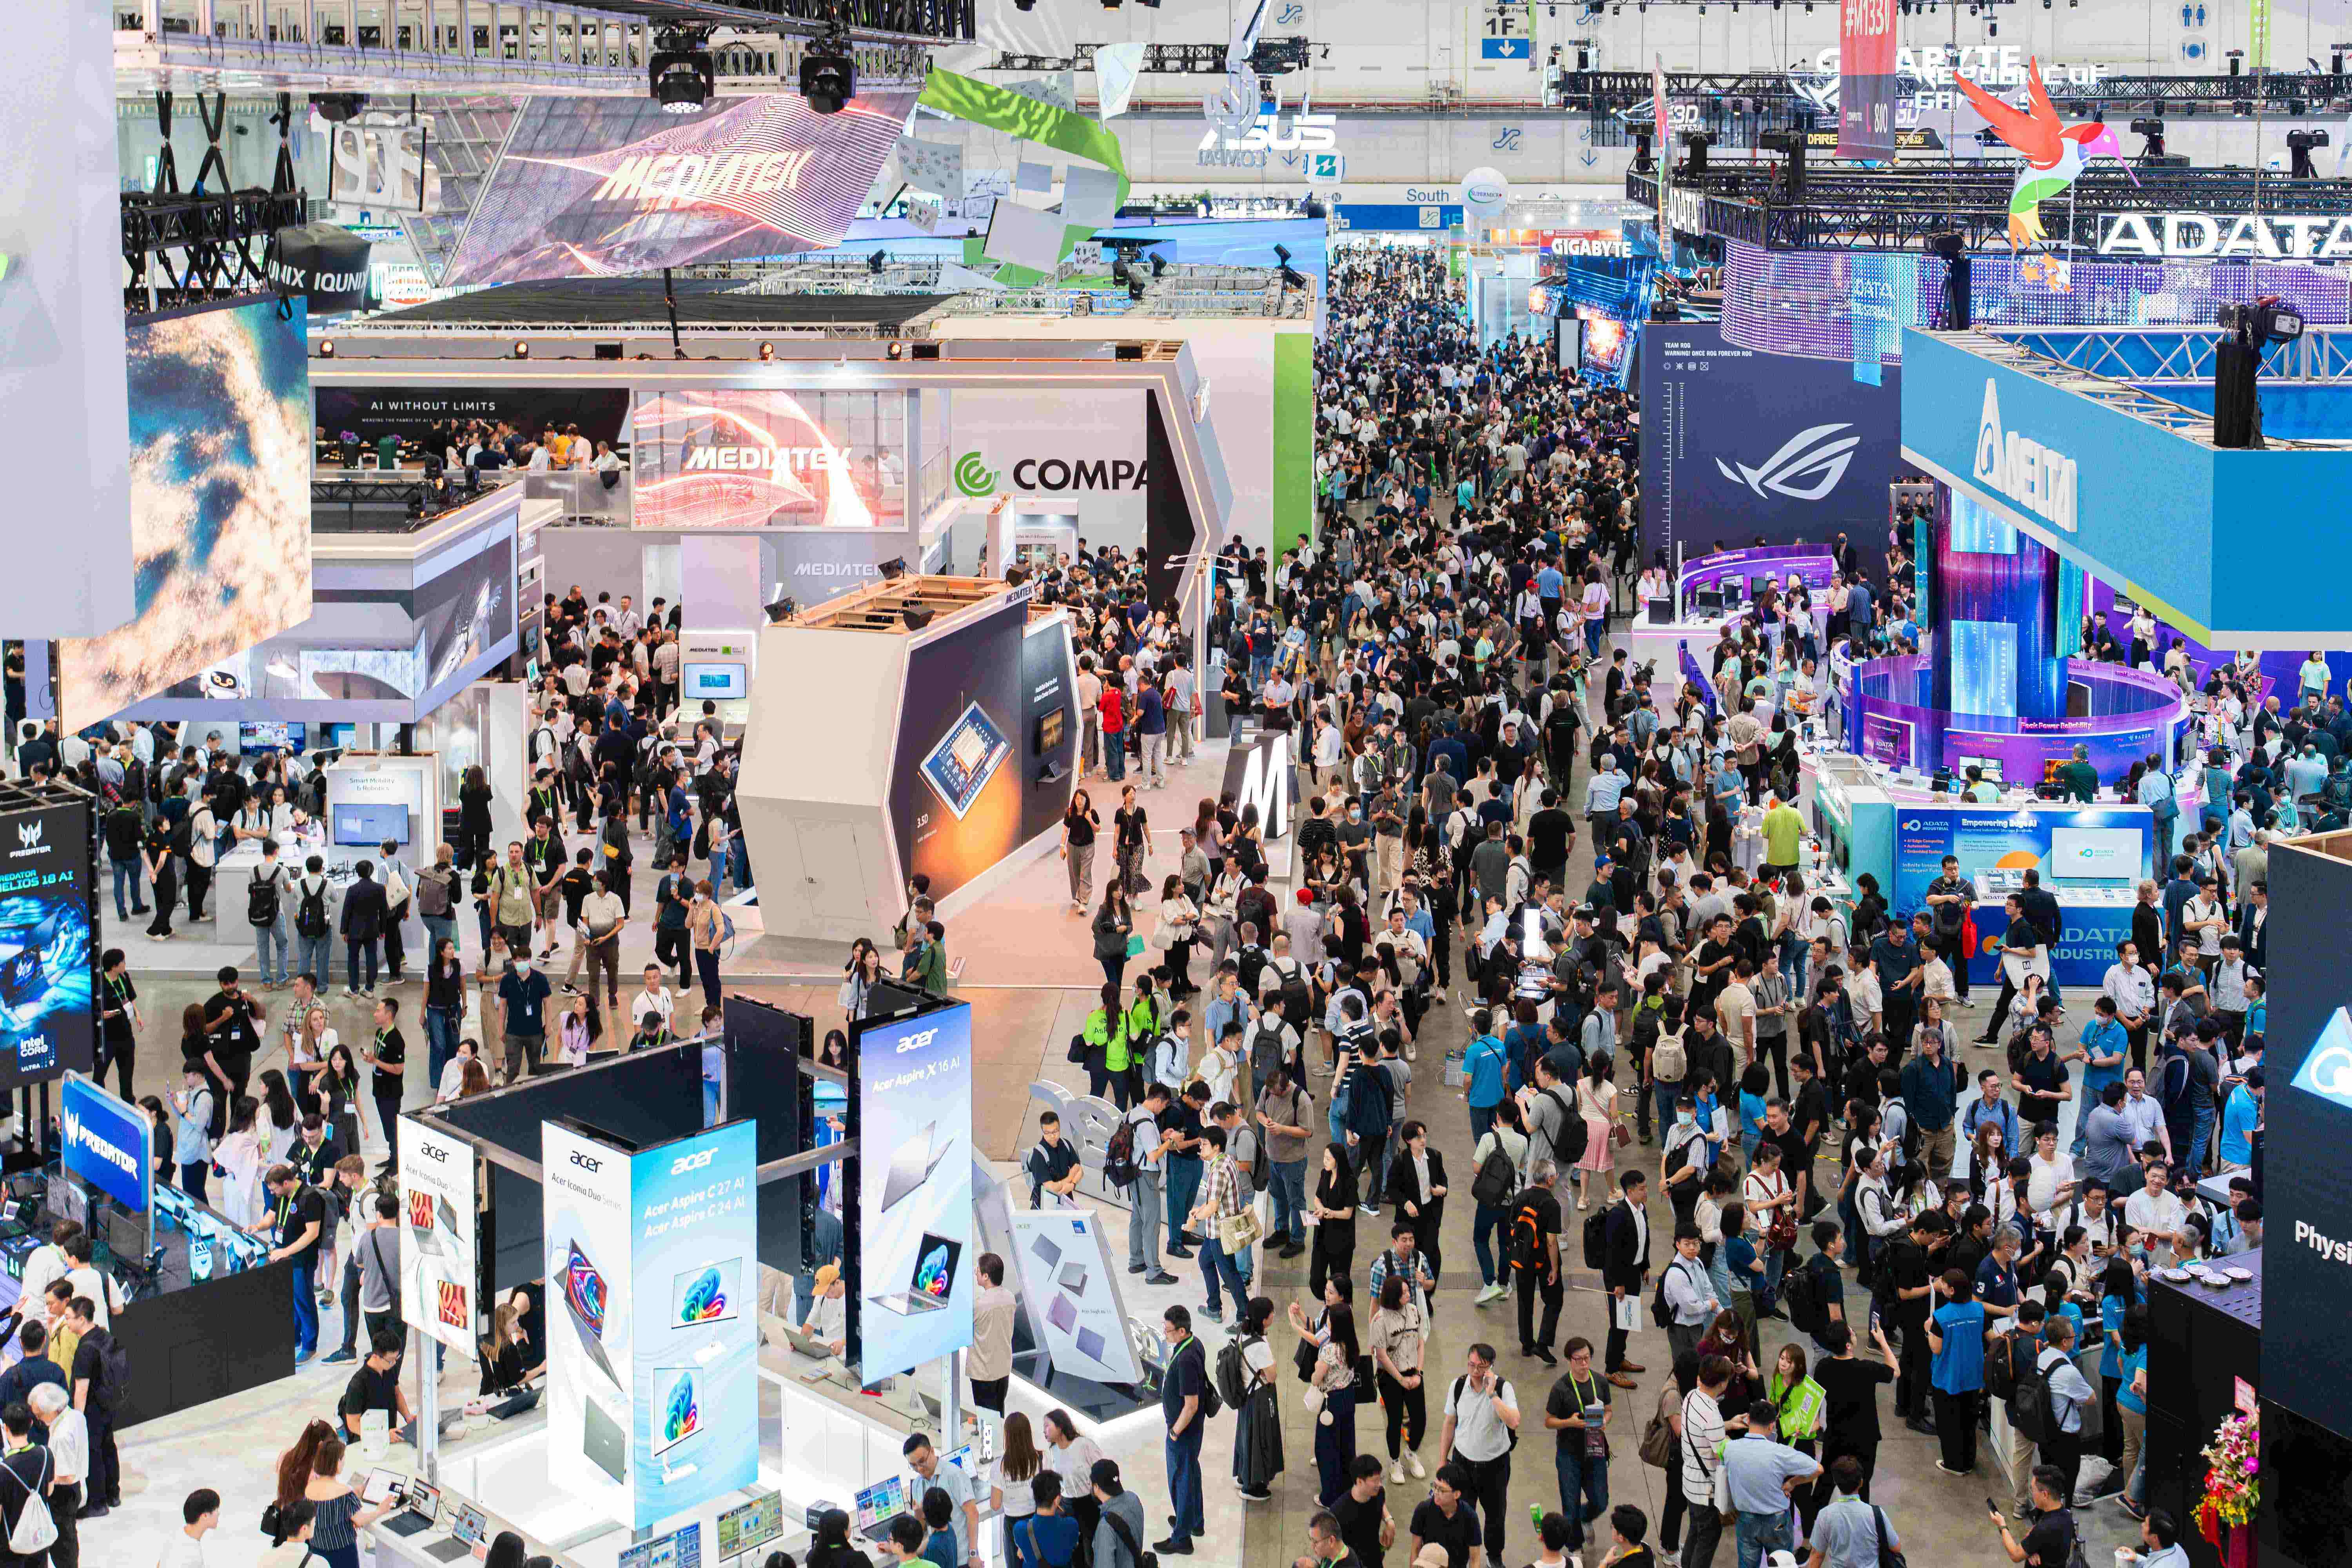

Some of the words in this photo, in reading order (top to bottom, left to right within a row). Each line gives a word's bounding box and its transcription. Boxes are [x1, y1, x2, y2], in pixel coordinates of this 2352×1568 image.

[1486, 18, 1515, 35] 1F
[1808, 133, 1838, 145] DARE
[592, 150, 814, 201] MEDIATEK
[1406, 189, 1449, 202] South
[1551, 238, 1632, 258] GIGABYTE
[371, 401, 383, 411] AI
[389, 401, 448, 411] WITHOUT
[453, 401, 496, 411] LIMITS
[685, 446, 852, 470] MEDIATEK
[1013, 458, 1147, 490] COMPA
[1005, 585, 1032, 606] MEDIATEK
[1236, 730, 1288, 838] M
[917, 813, 928, 828] 3.5D
[1962, 818, 2008, 828] Empowering
[2009, 819, 2027, 829] Edge
[9, 845, 51, 859] PREDATOR
[0, 869, 37, 882] REDATOR
[42, 873, 56, 885] 18
[58, 869, 74, 882] AI
[2058, 928, 2133, 942] DATA
[2049, 949, 2118, 960] NDUSTRI
[20, 1034, 44, 1049] intel
[896, 1028, 939, 1053] acer
[21, 1063, 40, 1072] ULTRA
[872, 1078, 895, 1093] Acer
[895, 1069, 925, 1087] Aspire
[926, 1061, 936, 1080] X
[938, 1059, 949, 1073] 16
[951, 1056, 960, 1070] AI
[79, 1125, 138, 1181] PREDATOR
[421, 1142, 449, 1163] acer
[570, 1150, 603, 1173] acer
[671, 1147, 719, 1175] acer
[405, 1163, 417, 1177] Acer
[419, 1170, 436, 1185] Iconia
[436, 1177, 448, 1191] Duo
[552, 1172, 566, 1187] Acer
[567, 1180, 587, 1196] Iconia
[588, 1188, 601, 1202] Duo
[644, 1201, 670, 1220] Acer
[671, 1191, 705, 1211] Aspire
[707, 1185, 716, 1198] C
[717, 1179, 731, 1196] 27
[734, 1176, 746, 1190] AI
[644, 1221, 670, 1239] Acer
[671, 1210, 706, 1230] Aspire
[707, 1203, 716, 1217] C
[717, 1198, 731, 1215] 24
[734, 1195, 746, 1210] AI
[195, 1243, 207, 1253] AI
[2295, 1220, 2352, 1265] Physi
[1976, 1281, 1985, 1294] 3
